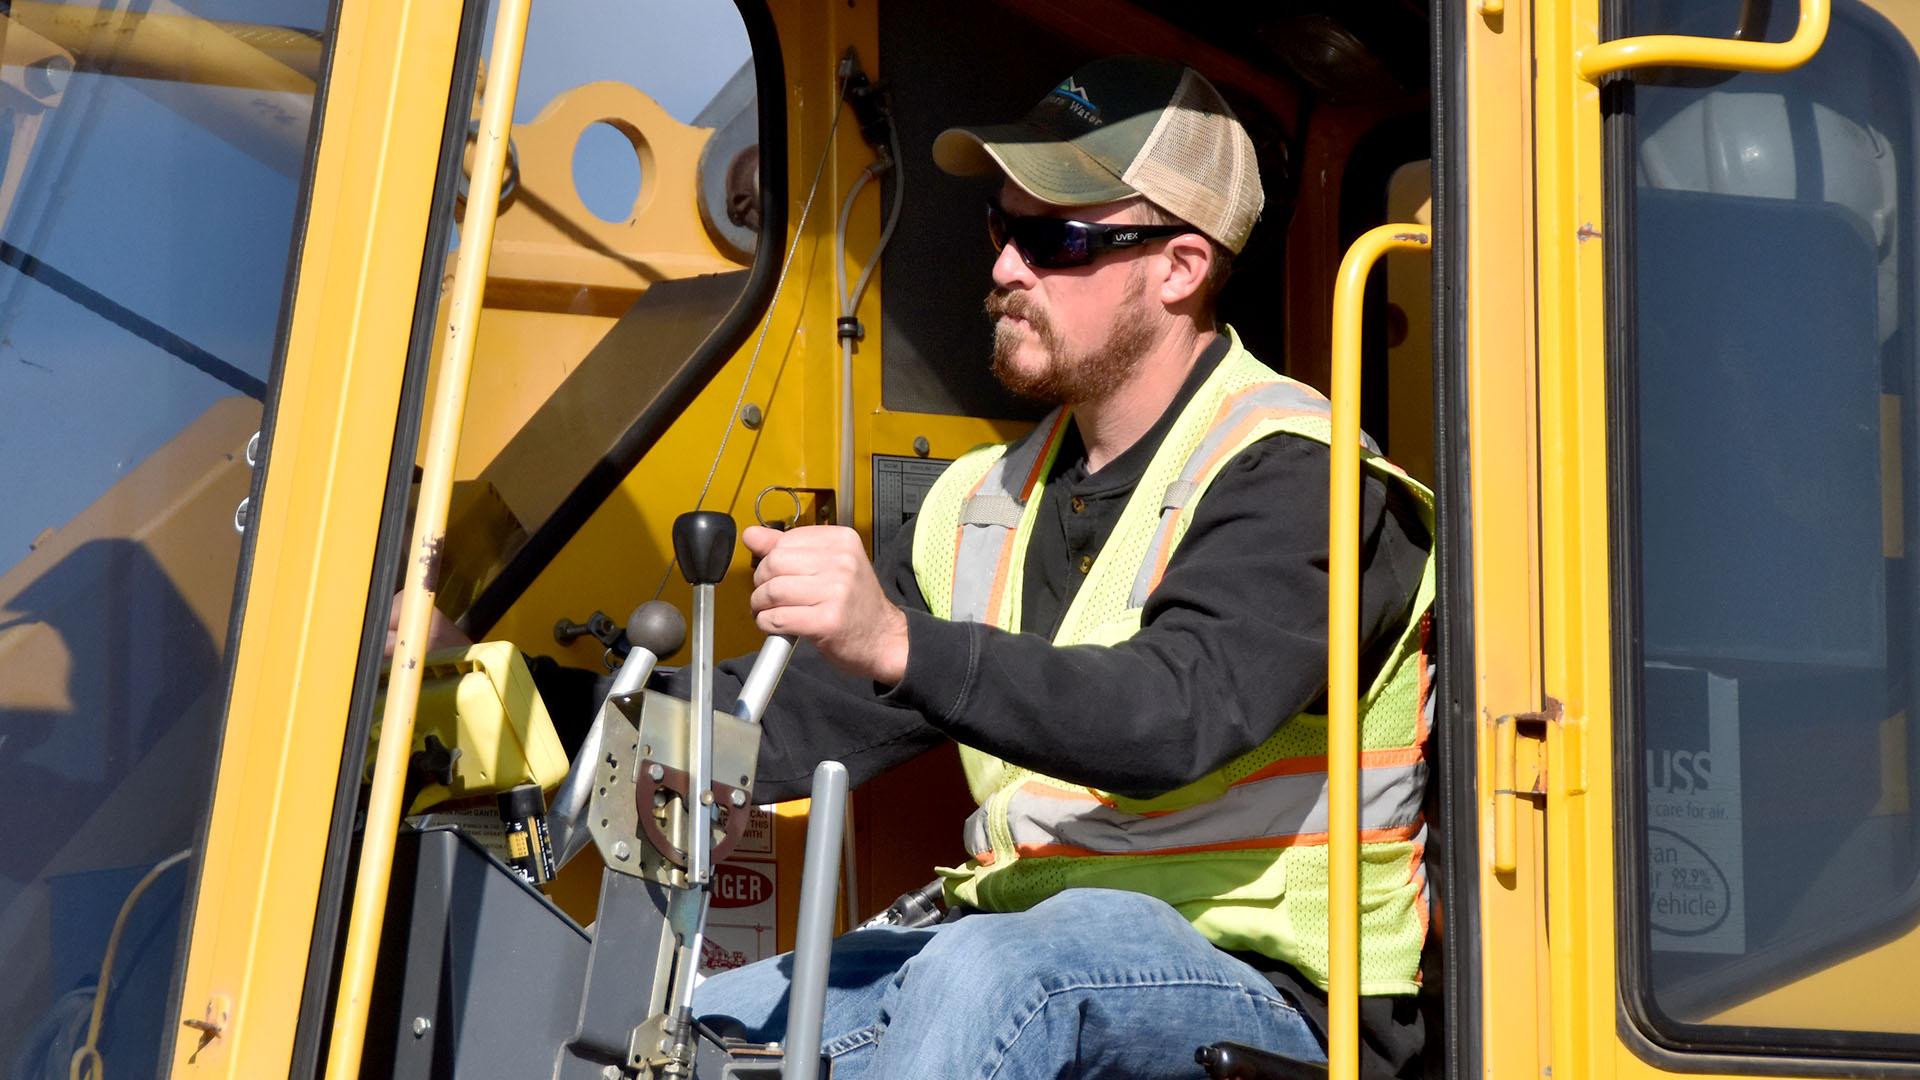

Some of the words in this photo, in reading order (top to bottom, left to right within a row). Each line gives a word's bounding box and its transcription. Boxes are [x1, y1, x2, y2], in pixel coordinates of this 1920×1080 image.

[1069, 100, 1103, 126] Water
[1115, 232, 1138, 242] UVEX
[750, 809, 768, 818] CAN
[1656, 803, 1684, 817] care
[1686, 800, 1706, 818] for
[751, 819, 769, 829] THIS
[743, 829, 763, 839] WITH
